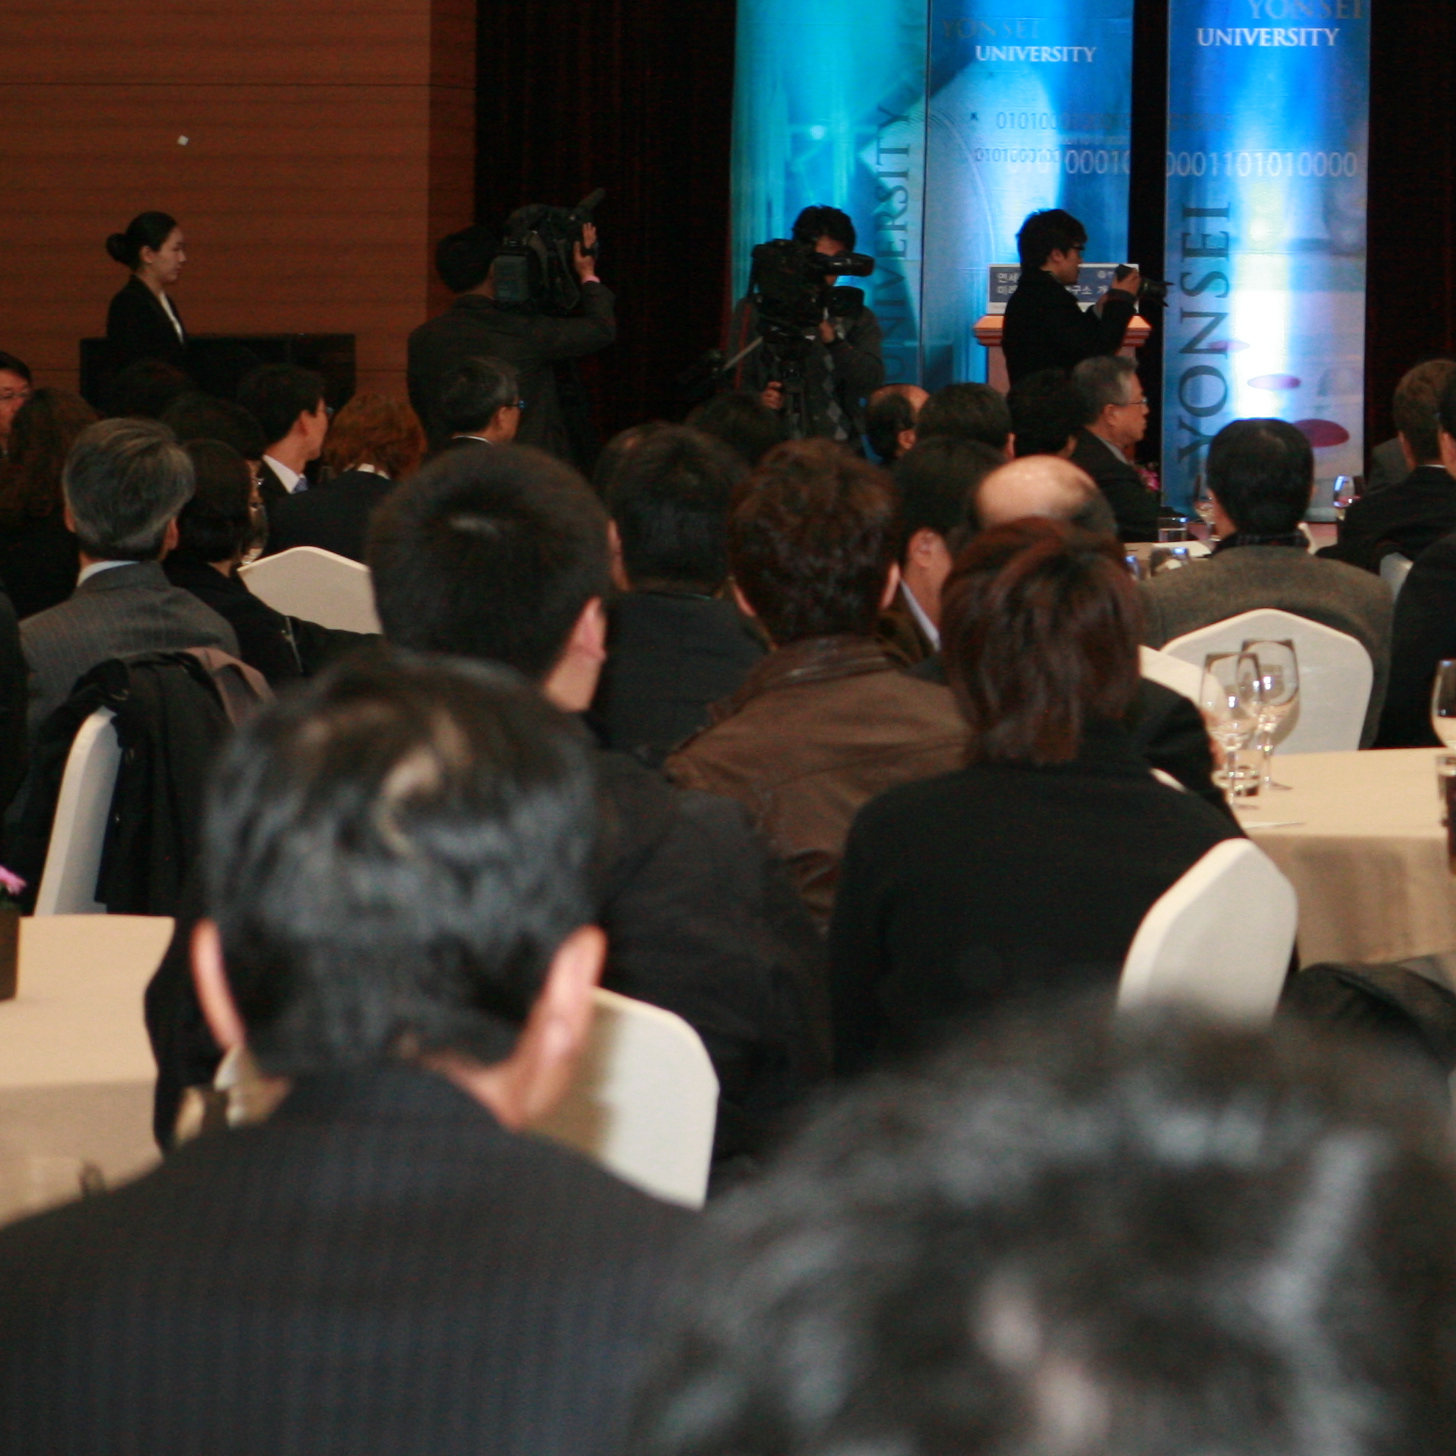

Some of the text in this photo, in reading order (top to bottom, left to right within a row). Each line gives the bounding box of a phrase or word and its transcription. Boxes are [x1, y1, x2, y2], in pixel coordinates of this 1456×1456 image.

[1197, 27, 1340, 47] UNIVERSITY
[975, 45, 1097, 63] UNIVERSITY
[1177, 201, 1231, 464] YONSEI
